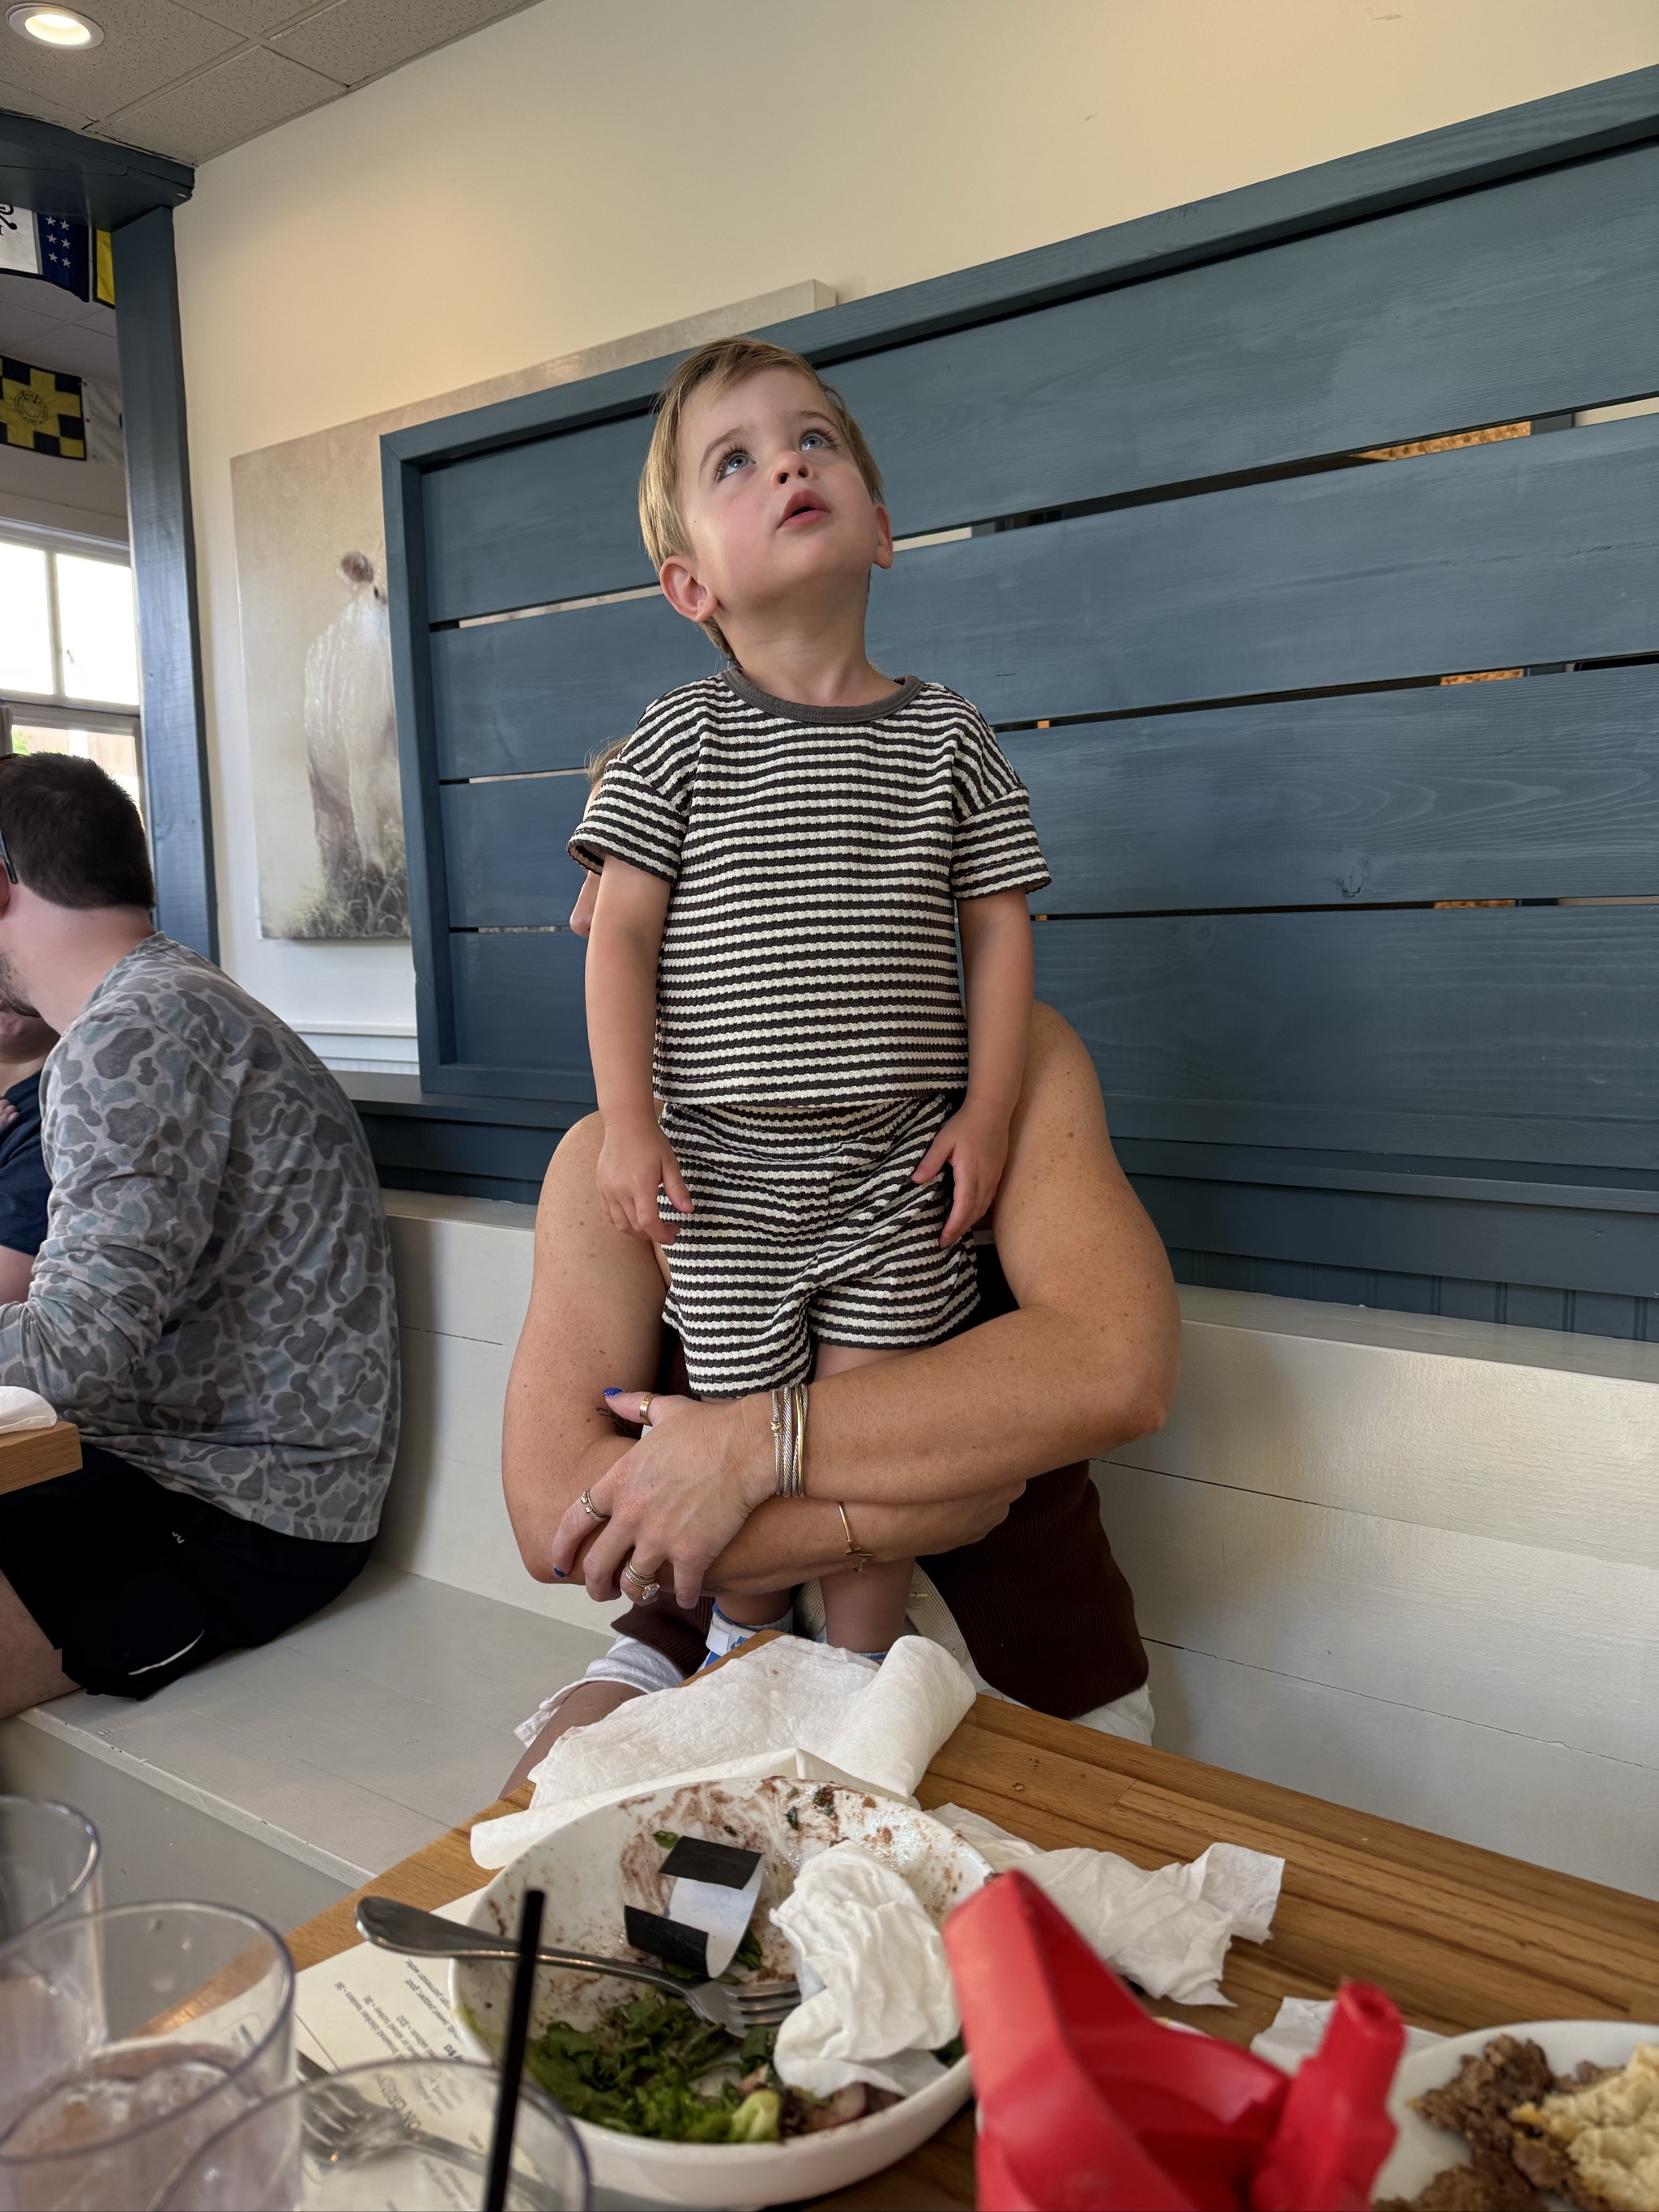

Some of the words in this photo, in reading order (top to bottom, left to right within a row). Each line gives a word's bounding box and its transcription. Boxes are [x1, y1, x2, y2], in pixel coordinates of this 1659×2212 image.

[404, 1979, 420, 1991] goat
[417, 1972, 444, 1998] parmesan
[345, 1991, 363, 2012] tenders
[360, 2010, 380, 2031] chicken
[374, 2006, 390, 2026] turkey
[432, 2009, 449, 2026] sweet
[386, 2022, 403, 2039] sliced
[410, 2028, 429, 2048] salmon
